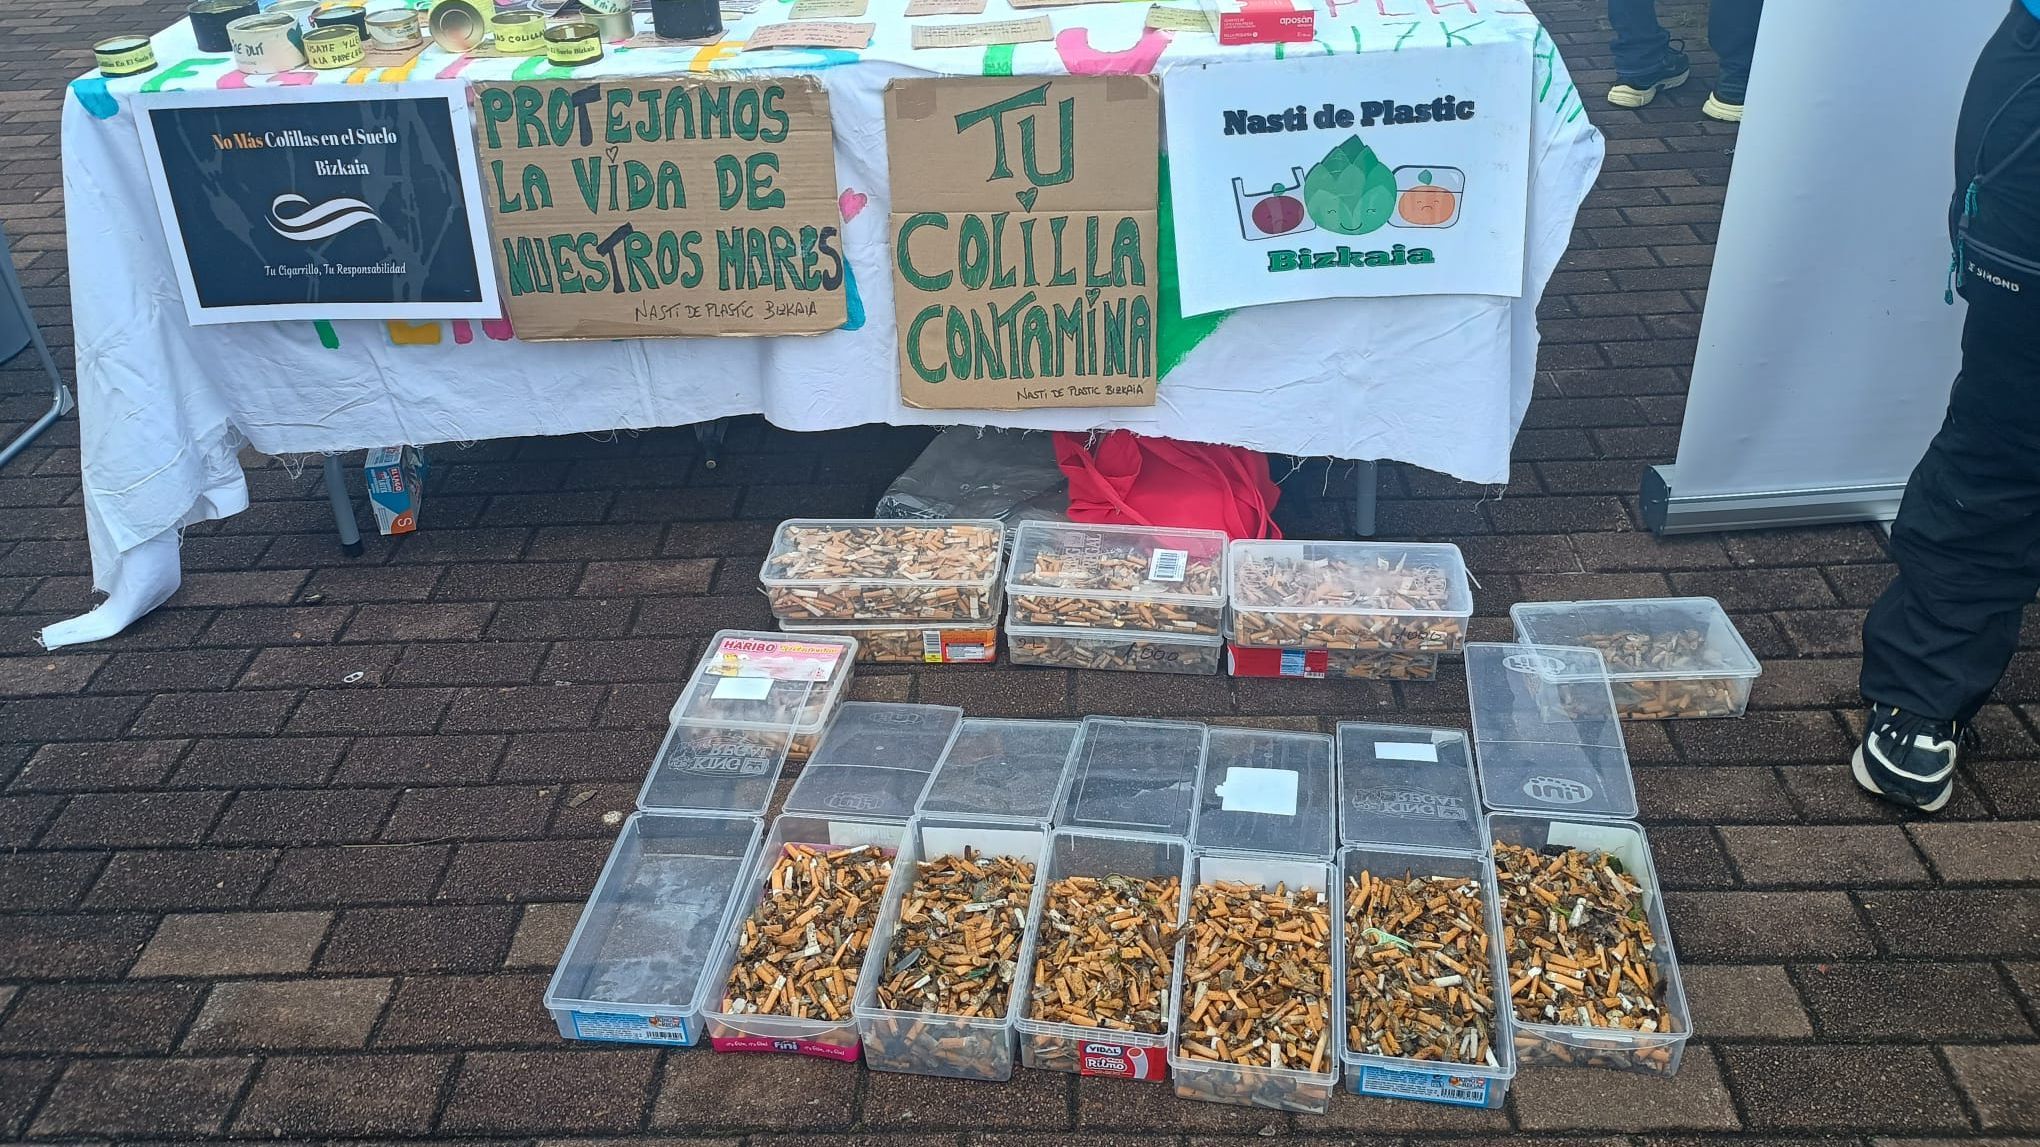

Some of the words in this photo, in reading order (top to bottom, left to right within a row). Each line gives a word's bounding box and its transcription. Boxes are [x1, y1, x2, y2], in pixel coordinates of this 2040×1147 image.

[479, 83, 790, 149] PROTEJAMOS
[1223, 105, 1308, 135] Nasti
[1314, 104, 1354, 130] de
[1360, 95, 1475, 127] Plastic
[212, 133, 233, 150] No
[264, 130, 319, 148] Colillas
[321, 133, 339, 146] en
[341, 128, 354, 146] el
[356, 127, 397, 145] Suelo
[955, 81, 1075, 187] TU
[314, 158, 370, 176] Bizkaia
[491, 159, 554, 214] LA
[714, 151, 786, 212] DE
[502, 222, 704, 297] NUESTROS
[716, 225, 844, 292] MARES
[1267, 244, 1435, 272] Bizkaia
[264, 265, 276, 276] Tu
[278, 264, 322, 279] Cigarrillo,
[323, 263, 335, 275] Tu
[336, 262, 406, 277] Responsabilidad
[1977, 267, 2020, 292] SIMOND
[685, 304, 701, 319] DE
[1050, 388, 1065, 398] DE
[723, 640, 777, 653] HARIBO
[1089, 1046, 1120, 1054] VIDAL
